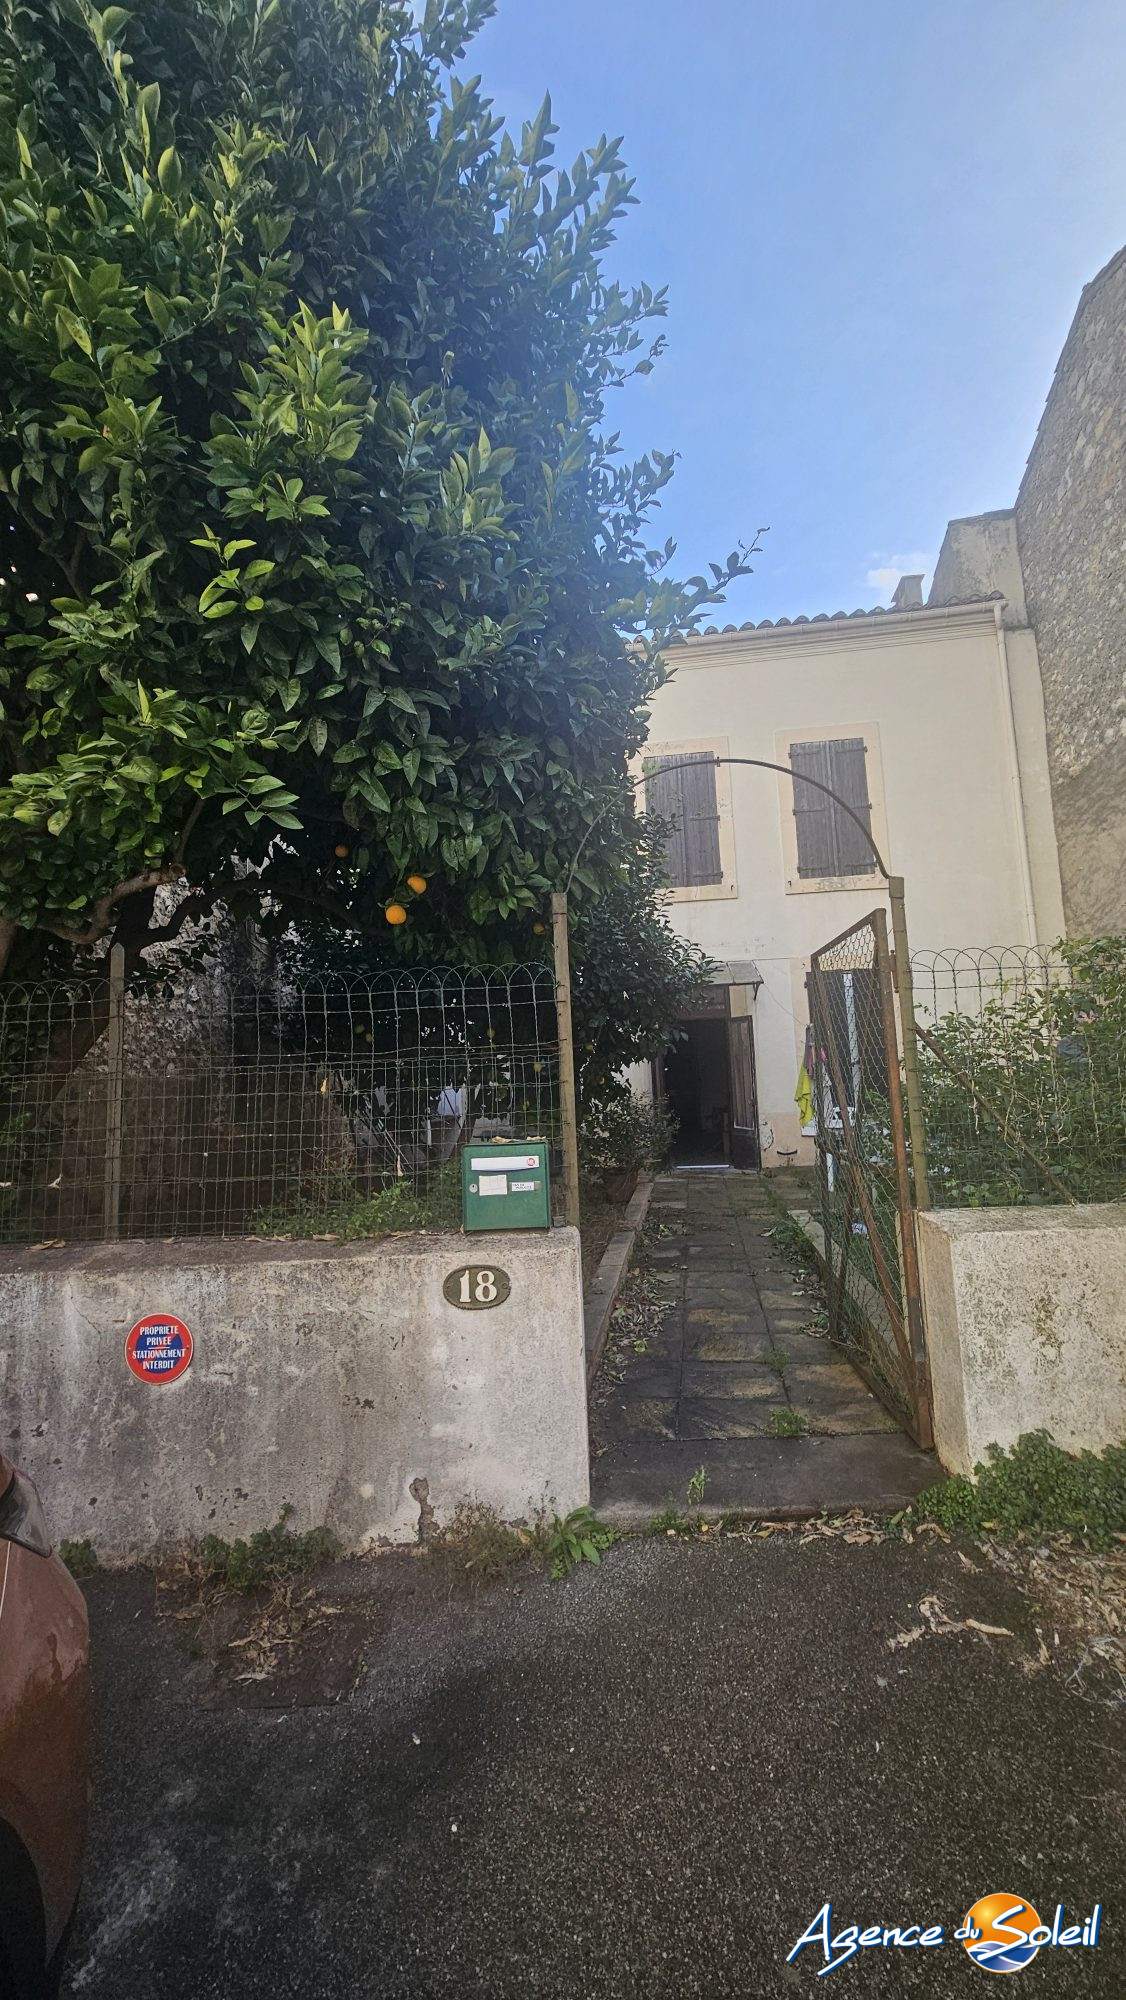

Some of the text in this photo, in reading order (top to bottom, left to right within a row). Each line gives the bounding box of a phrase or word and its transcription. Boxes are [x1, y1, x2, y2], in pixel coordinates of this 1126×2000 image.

[459, 1270, 497, 1303] 18
[132, 1348, 186, 1359] STATIONNEMENT
[143, 1360, 175, 1370] INTERDIT
